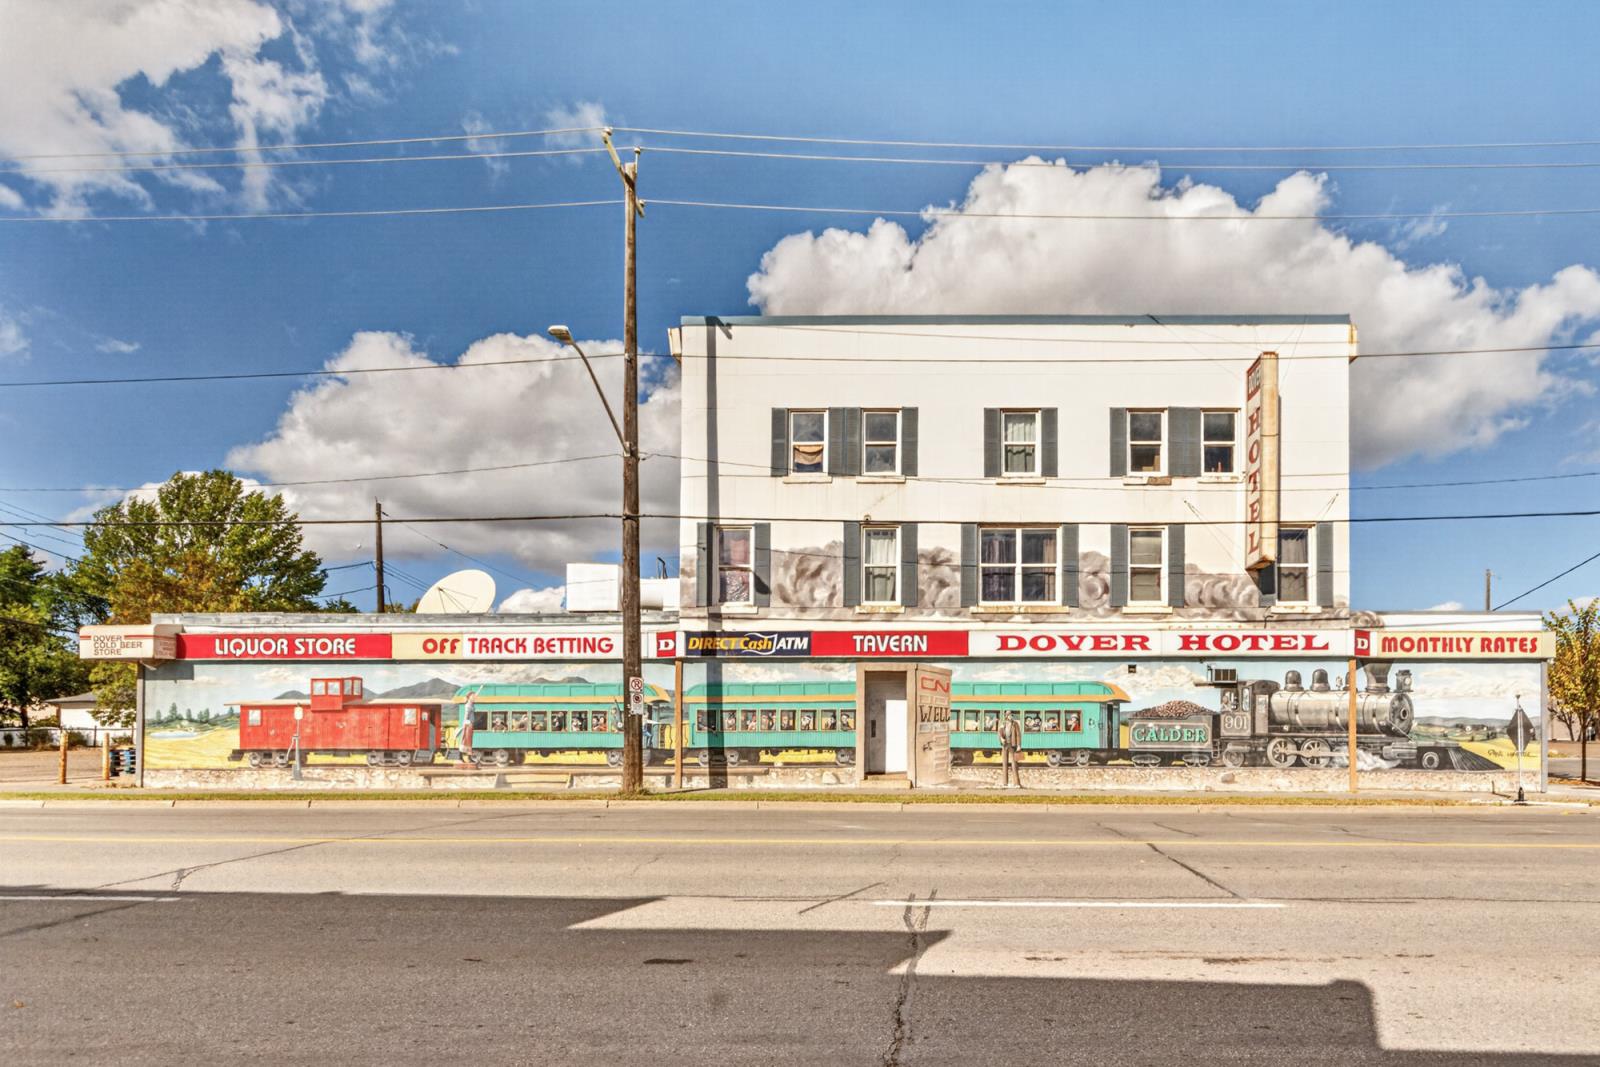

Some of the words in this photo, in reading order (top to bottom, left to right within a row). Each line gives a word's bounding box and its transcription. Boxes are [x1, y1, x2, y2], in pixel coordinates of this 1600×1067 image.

[1247, 406, 1261, 554] HOTEL
[120, 641, 143, 649] BEER
[215, 638, 288, 657] LIQUOR
[294, 638, 356, 655] STORE
[422, 638, 460, 654] OFF
[468, 637, 527, 654] TRACK
[533, 637, 614, 654] BETTING
[659, 638, 675, 651] D
[775, 637, 809, 650] ATM
[852, 635, 928, 652] TAVERN
[995, 635, 1152, 651] DOVER
[1178, 634, 1329, 651] HOTEL
[1357, 638, 1368, 649] D
[1381, 636, 1474, 653] MONTHLY
[1480, 636, 1538, 653] RATES
[1224, 715, 1248, 730] 901
[1133, 727, 1208, 743] CALDER
